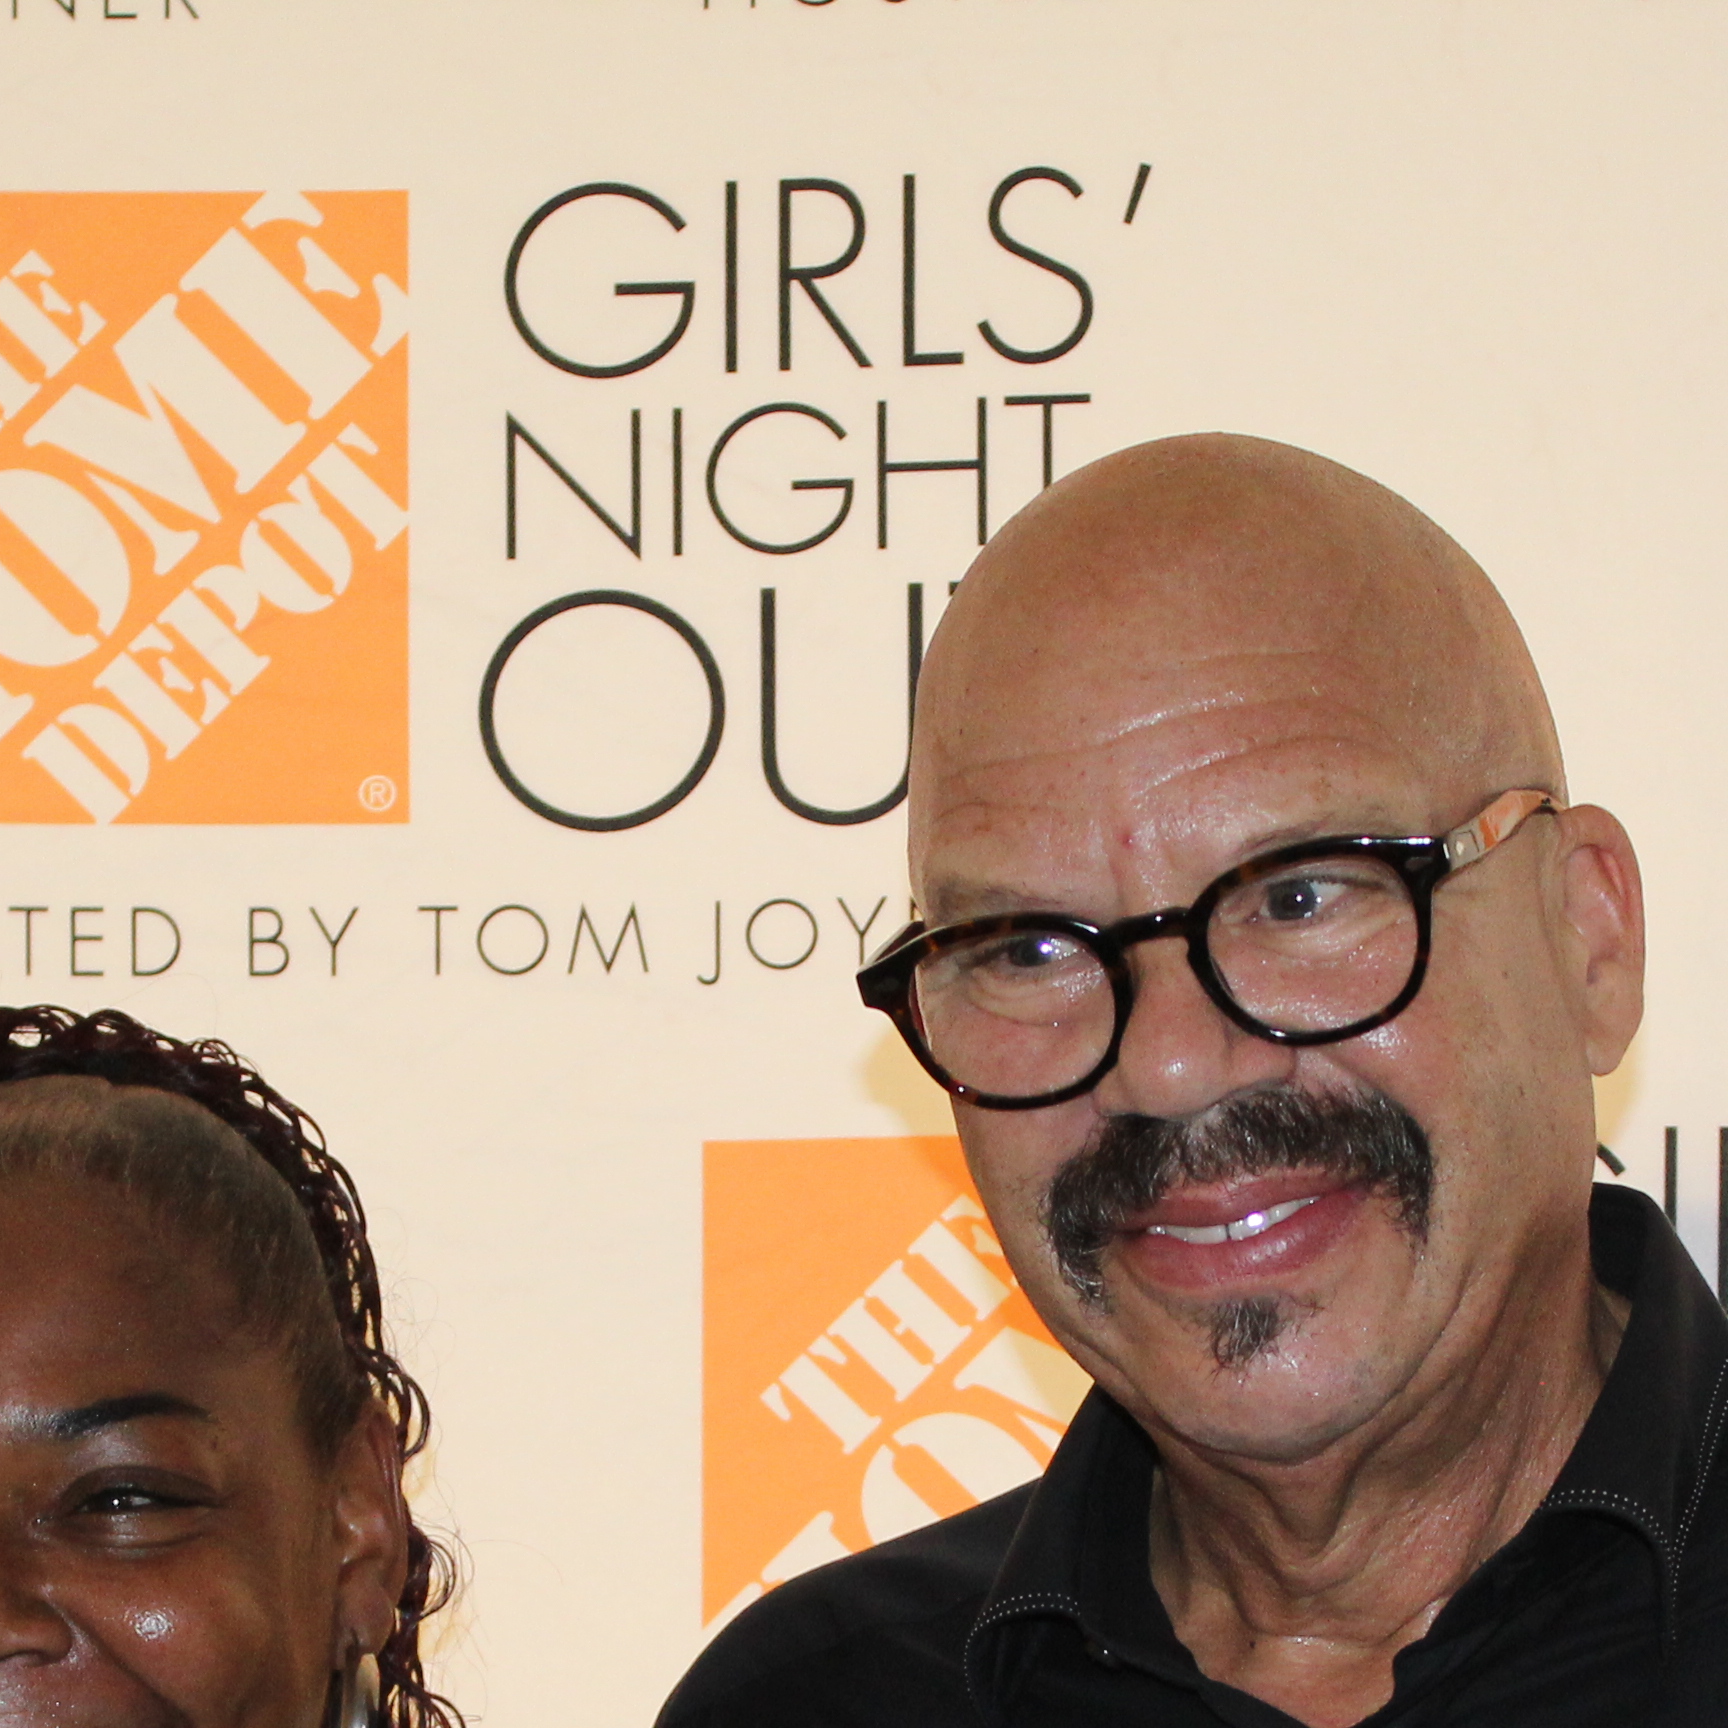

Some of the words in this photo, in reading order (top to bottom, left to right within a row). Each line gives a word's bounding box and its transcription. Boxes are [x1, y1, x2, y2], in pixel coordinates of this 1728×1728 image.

[503, 162, 1153, 379] GIRLS'
[21, 423, 409, 825] DEPOT
[478, 579, 962, 833] OU
[248, 905, 359, 978] BY
[417, 903, 650, 978] TOM
